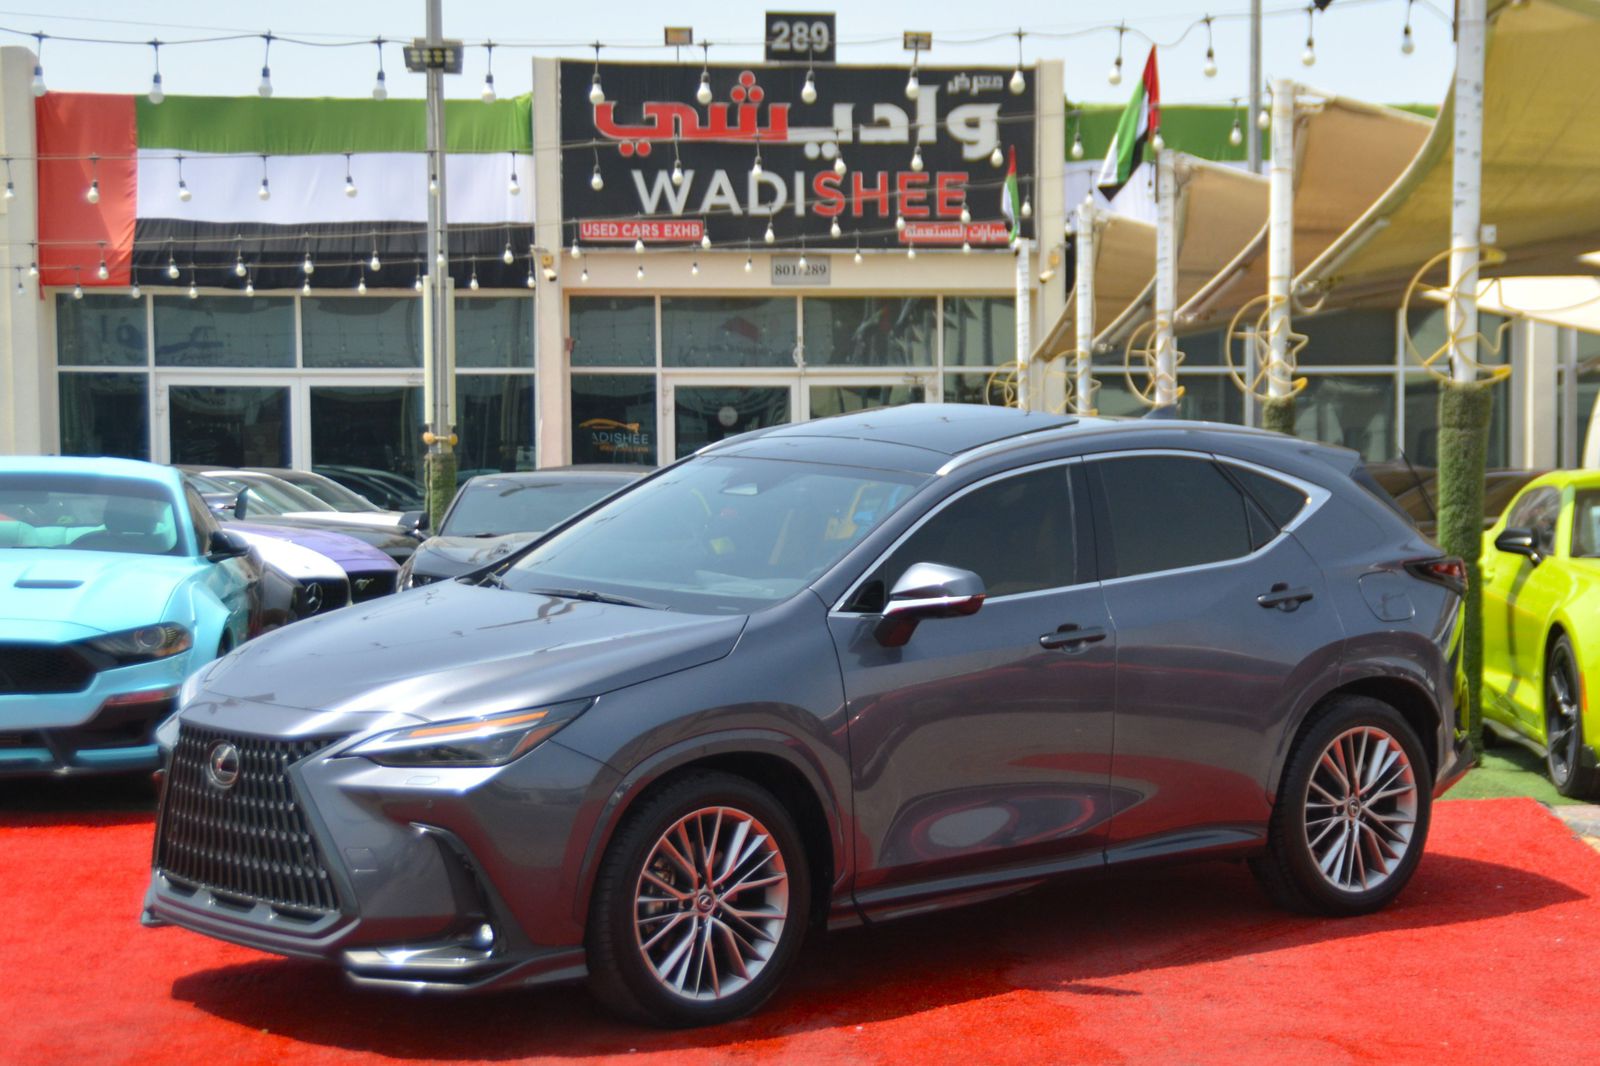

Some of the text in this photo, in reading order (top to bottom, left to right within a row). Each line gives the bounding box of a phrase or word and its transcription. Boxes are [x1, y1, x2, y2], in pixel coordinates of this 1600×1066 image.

[771, 21, 829, 52] 289
[947, 72, 1004, 96] معرض
[630, 169, 970, 218] WADISHEE
[582, 223, 700, 238] USED CARS EXHB
